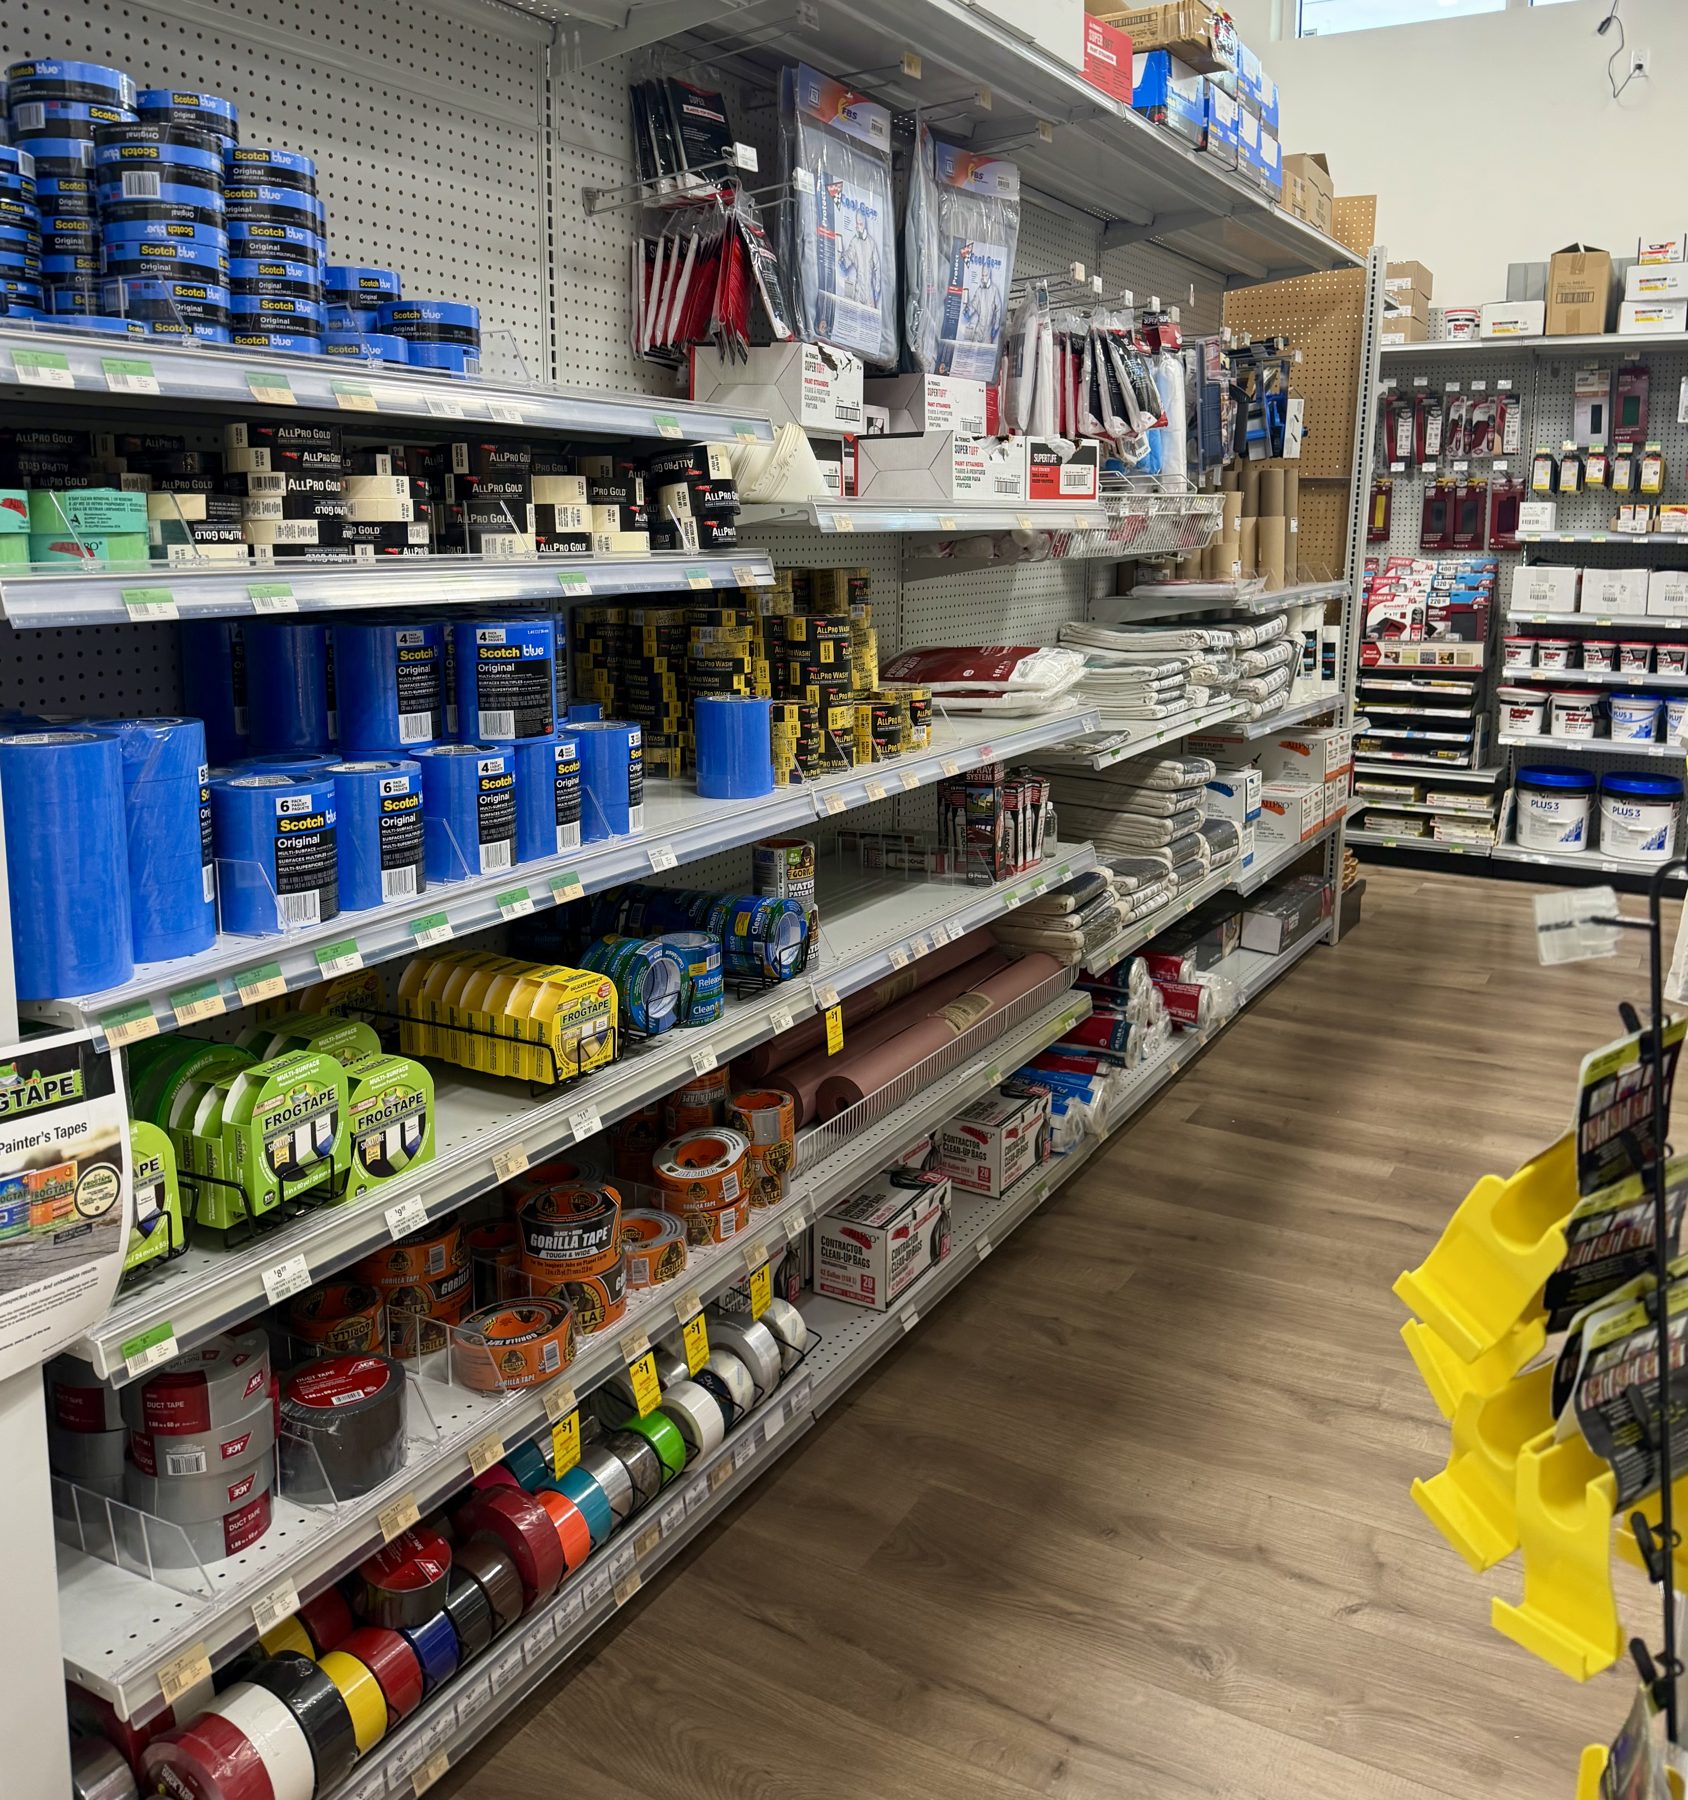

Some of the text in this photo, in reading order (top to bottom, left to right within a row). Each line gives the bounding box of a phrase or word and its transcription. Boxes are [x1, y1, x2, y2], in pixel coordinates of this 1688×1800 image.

[173, 94, 217, 109] Scotch blue
[91, 108, 119, 122] Scotch
[174, 111, 196, 120] Original
[842, 106, 857, 120] FBS
[126, 132, 159, 140] Original
[121, 147, 158, 158] Scotch
[235, 151, 292, 165] Scotch blue
[233, 168, 264, 178] Original
[59, 181, 87, 191] Scotch
[224, 188, 281, 201] Scotch blue
[58, 198, 84, 206] Original
[171, 210, 195, 219] Original
[55, 220, 88, 231] Scotch
[147, 224, 194, 236] Scotch blue
[251, 226, 304, 242] Scotch blue
[55, 237, 84, 246] Original
[249, 243, 280, 252] Original
[141, 245, 196, 259] Scotch blue
[140, 263, 172, 272] Original
[259, 265, 303, 278] Scotch blue
[258, 282, 282, 290] Original
[360, 278, 391, 290] Scotch blue
[175, 286, 206, 299] Scotch
[175, 304, 203, 313] Original
[261, 300, 311, 314] Scotch blue
[393, 309, 441, 320] Scotch blue
[260, 316, 290, 326] Original
[154, 323, 214, 336] Scotch blue
[234, 335, 293, 347] Scotch blue
[328, 344, 382, 356] Scotch blue
[53, 432, 73, 443] GOLD
[313, 428, 331, 440] GOLD
[552, 463, 568, 472] GOLD
[192, 479, 213, 489] GOLD
[325, 480, 341, 492] GOLD
[505, 482, 523, 492] GOLD
[610, 487, 626, 497] GOLD
[315, 506, 334, 515] GOLD
[490, 513, 513, 523] GOLD
[195, 530, 218, 540] GOLD
[358, 525, 380, 535] GOLD
[570, 542, 587, 552] GOLD
[400, 633, 408, 644] 4
[479, 631, 487, 643] 4
[400, 649, 433, 661] Scotch
[480, 643, 544, 658] Scotch blue
[399, 664, 430, 675] Original
[478, 663, 515, 673] Original
[630, 735, 635, 745] 3
[558, 748, 565, 758] 4
[482, 763, 489, 774] 4
[200, 769, 206, 781] 9
[383, 782, 391, 794] 6
[482, 775, 513, 790] Scotch
[556, 776, 580, 788] Original
[383, 796, 418, 812] Scotch
[479, 792, 510, 805] Original
[1531, 799, 1559, 810] PLUS 3
[280, 800, 290, 812] 6
[1612, 806, 1641, 817] PLUS 3
[280, 815, 324, 832] Scotch
[381, 813, 416, 828] Original
[277, 834, 320, 848] Original
[278, 846, 316, 856] MULTI-SURFACE
[278, 856, 303, 865] SURFACES
[751, 911, 762, 935] Clean
[698, 974, 722, 988] Release
[562, 999, 609, 1024] FROGTAPE
[693, 1003, 715, 1015] Clean
[831, 1010, 838, 1023] $1
[277, 1059, 320, 1082] MULTI-SURFACE
[369, 1065, 409, 1086] MULTI-SURFACE
[264, 1088, 335, 1130] FROGTAPE
[358, 1092, 423, 1130] FROGTAPE
[54, 1121, 88, 1141] Tapes
[943, 1133, 980, 1150] CONTRACTOR
[943, 1142, 987, 1161] CLEAN-UP BAGS
[980, 1169, 989, 1178] 20
[530, 1227, 608, 1249] GORILLA TAPE
[821, 1235, 863, 1255] CONTRACTOR
[574, 1249, 591, 1257] WIDE
[821, 1246, 870, 1268] CLEAN-UP BAGS
[660, 1259, 684, 1277] GORILLA
[441, 1270, 470, 1294] GORILLA
[757, 1270, 765, 1282] $1
[863, 1276, 873, 1288] 20
[691, 1321, 701, 1335] $1
[413, 1339, 446, 1352] GORILLA
[639, 1361, 650, 1375] $1
[250, 1373, 263, 1389] ACE
[521, 1374, 536, 1383] TAPE
[147, 1401, 164, 1409] DUCT
[562, 1419, 572, 1433] $1
[226, 1441, 243, 1455] ACE
[233, 1482, 249, 1498] ACE
[229, 1508, 261, 1532] DUCT TAPE
